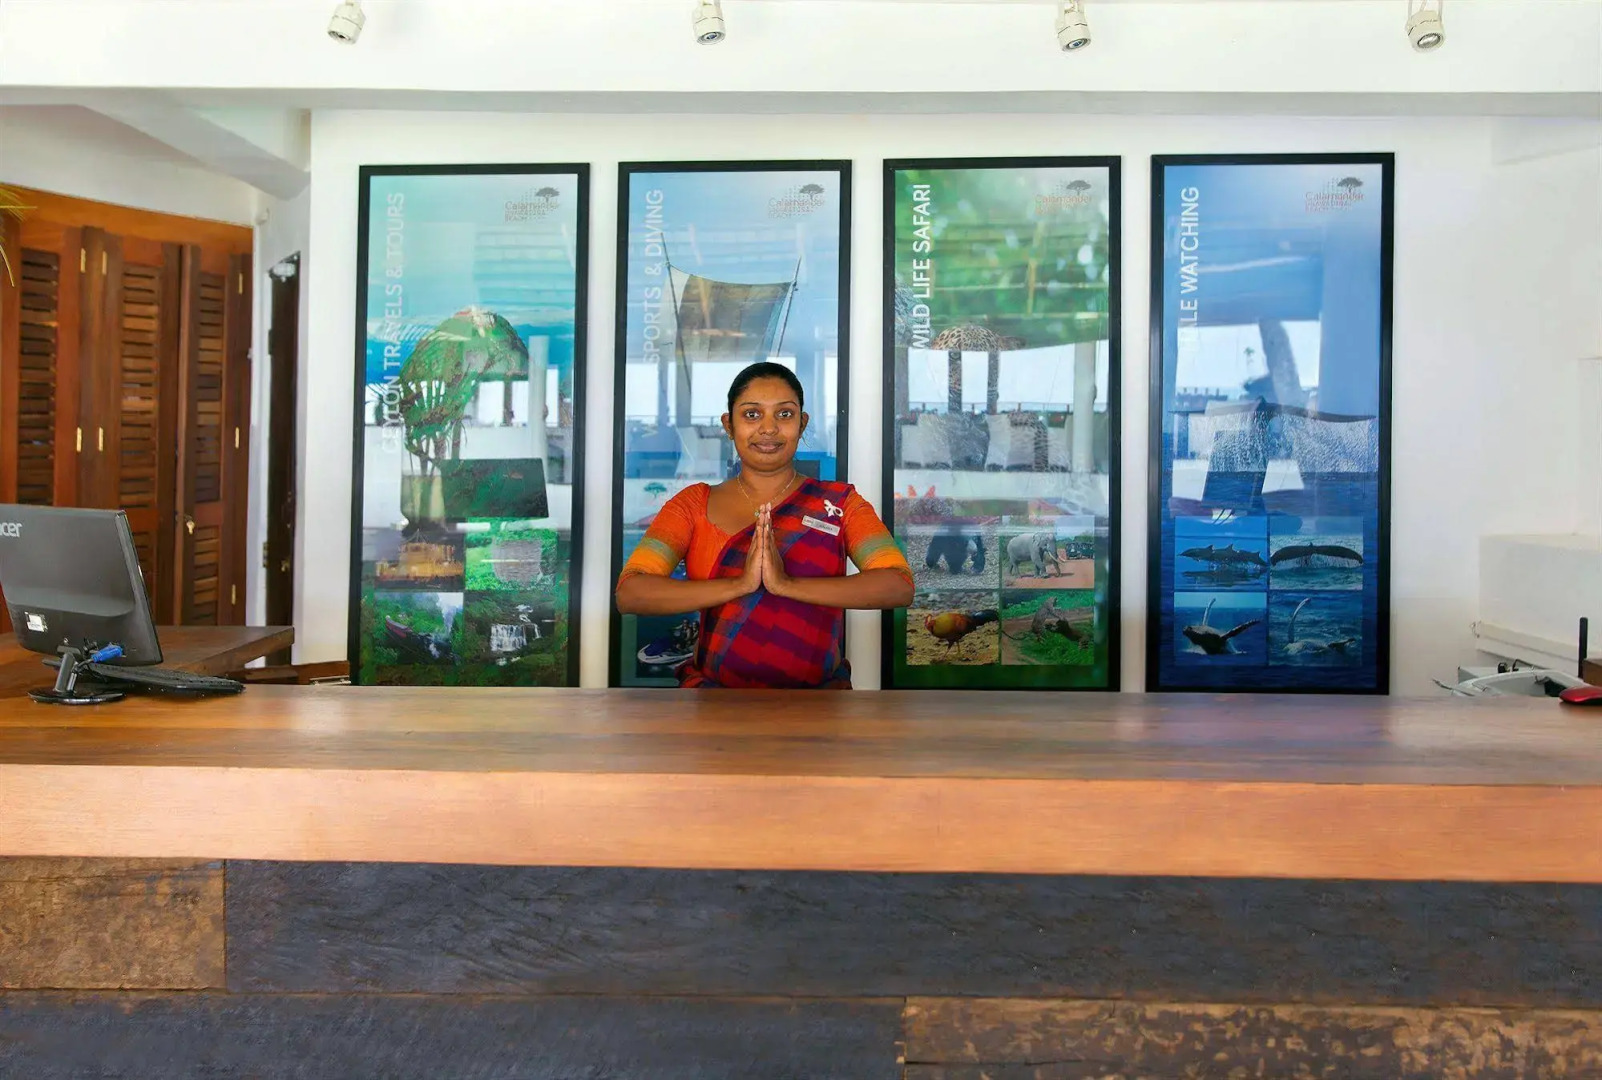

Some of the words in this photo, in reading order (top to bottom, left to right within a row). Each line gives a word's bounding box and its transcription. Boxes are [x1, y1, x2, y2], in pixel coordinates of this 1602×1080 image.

[386, 192, 405, 260] TOURS
[644, 189, 664, 257] DIVING
[912, 184, 931, 253] SAFARI
[1180, 186, 1200, 294] WATCHING
[386, 265, 403, 279] &
[644, 262, 663, 275] &
[912, 258, 931, 299] LIFE
[383, 284, 403, 370] TRAVELS
[642, 286, 662, 364] SPORTS
[912, 304, 931, 350] WILD
[0, 522, 23, 538] cer
